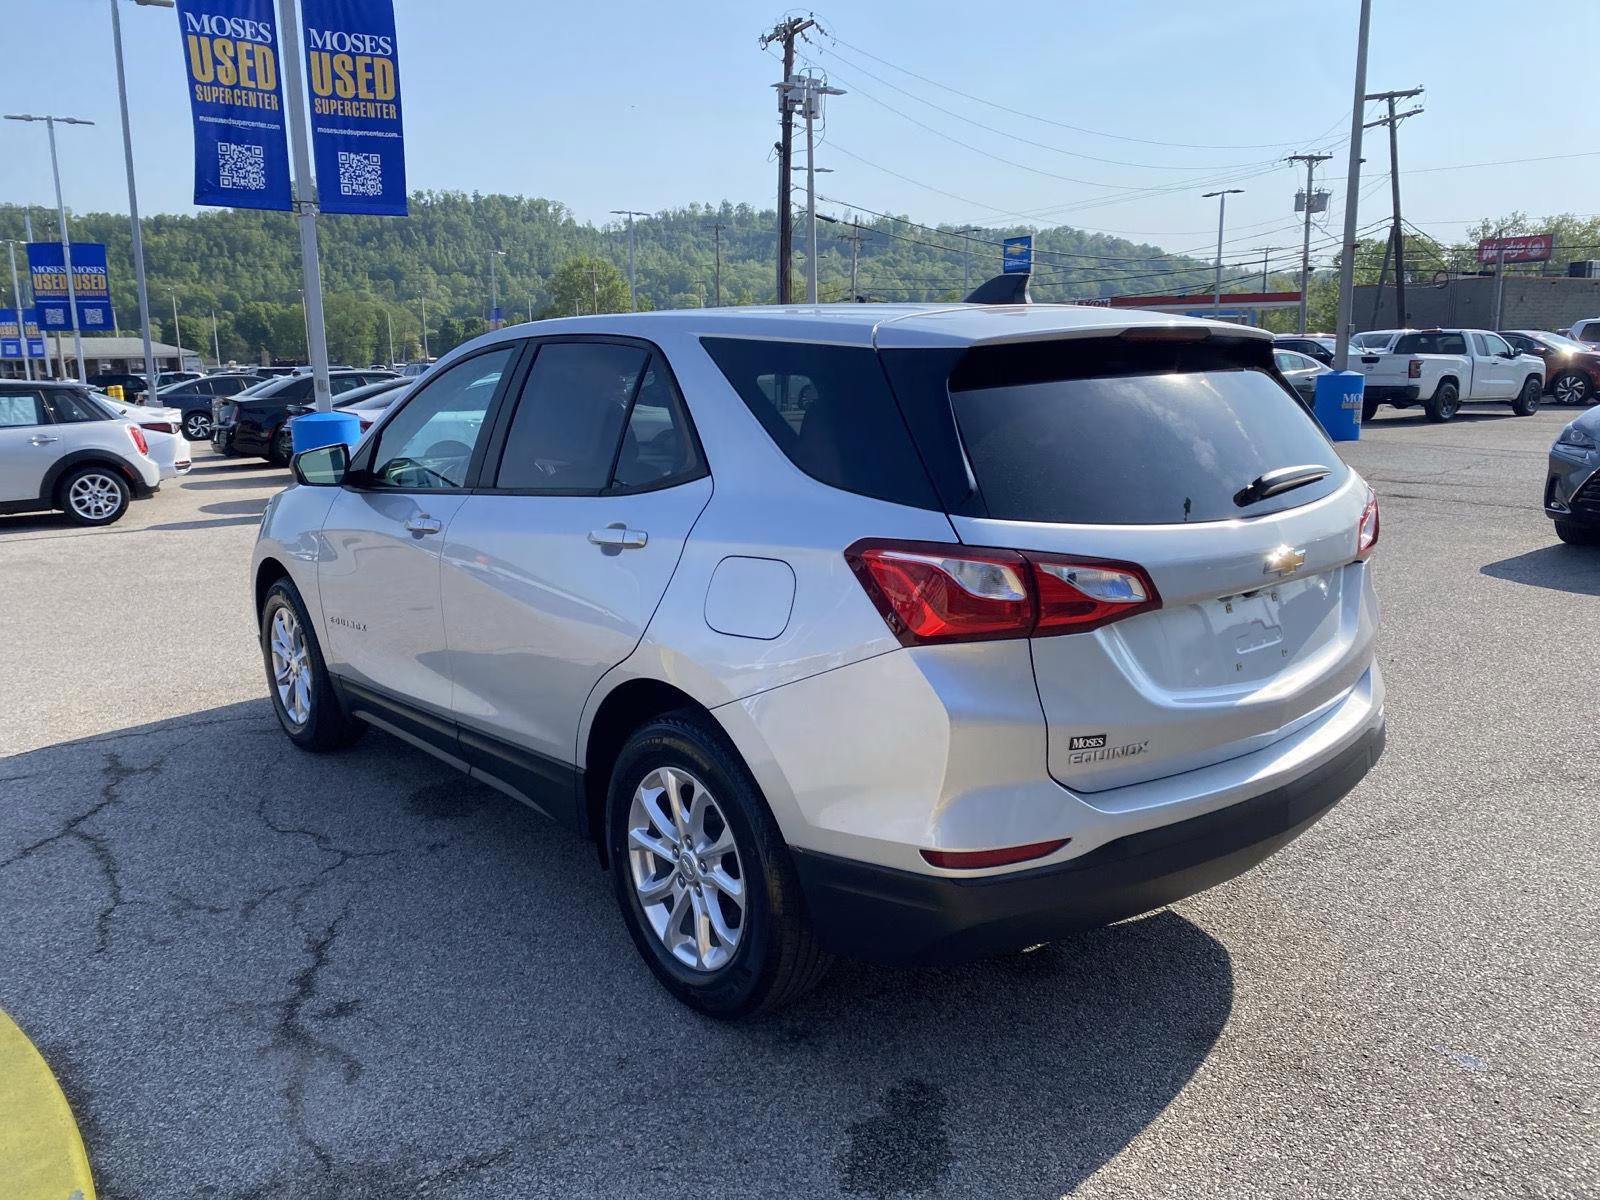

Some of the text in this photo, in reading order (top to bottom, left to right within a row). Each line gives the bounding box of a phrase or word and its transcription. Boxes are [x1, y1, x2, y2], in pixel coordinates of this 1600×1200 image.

[183, 11, 272, 44] MOSES
[308, 27, 392, 56] MOSES
[187, 34, 277, 91] USED
[310, 50, 396, 101] USED
[194, 83, 279, 111] SUPERCENTER
[314, 97, 397, 119] SUPERCENTER
[317, 127, 398, 138] mosesusedsupercenter.com
[32, 265, 66, 274] MOSES
[72, 265, 105, 274] MOSES
[32, 273, 67, 290] USED
[74, 273, 106, 290] USED
[1069, 740, 1149, 765] EQUINOX
[1072, 737, 1104, 749] MOSES
